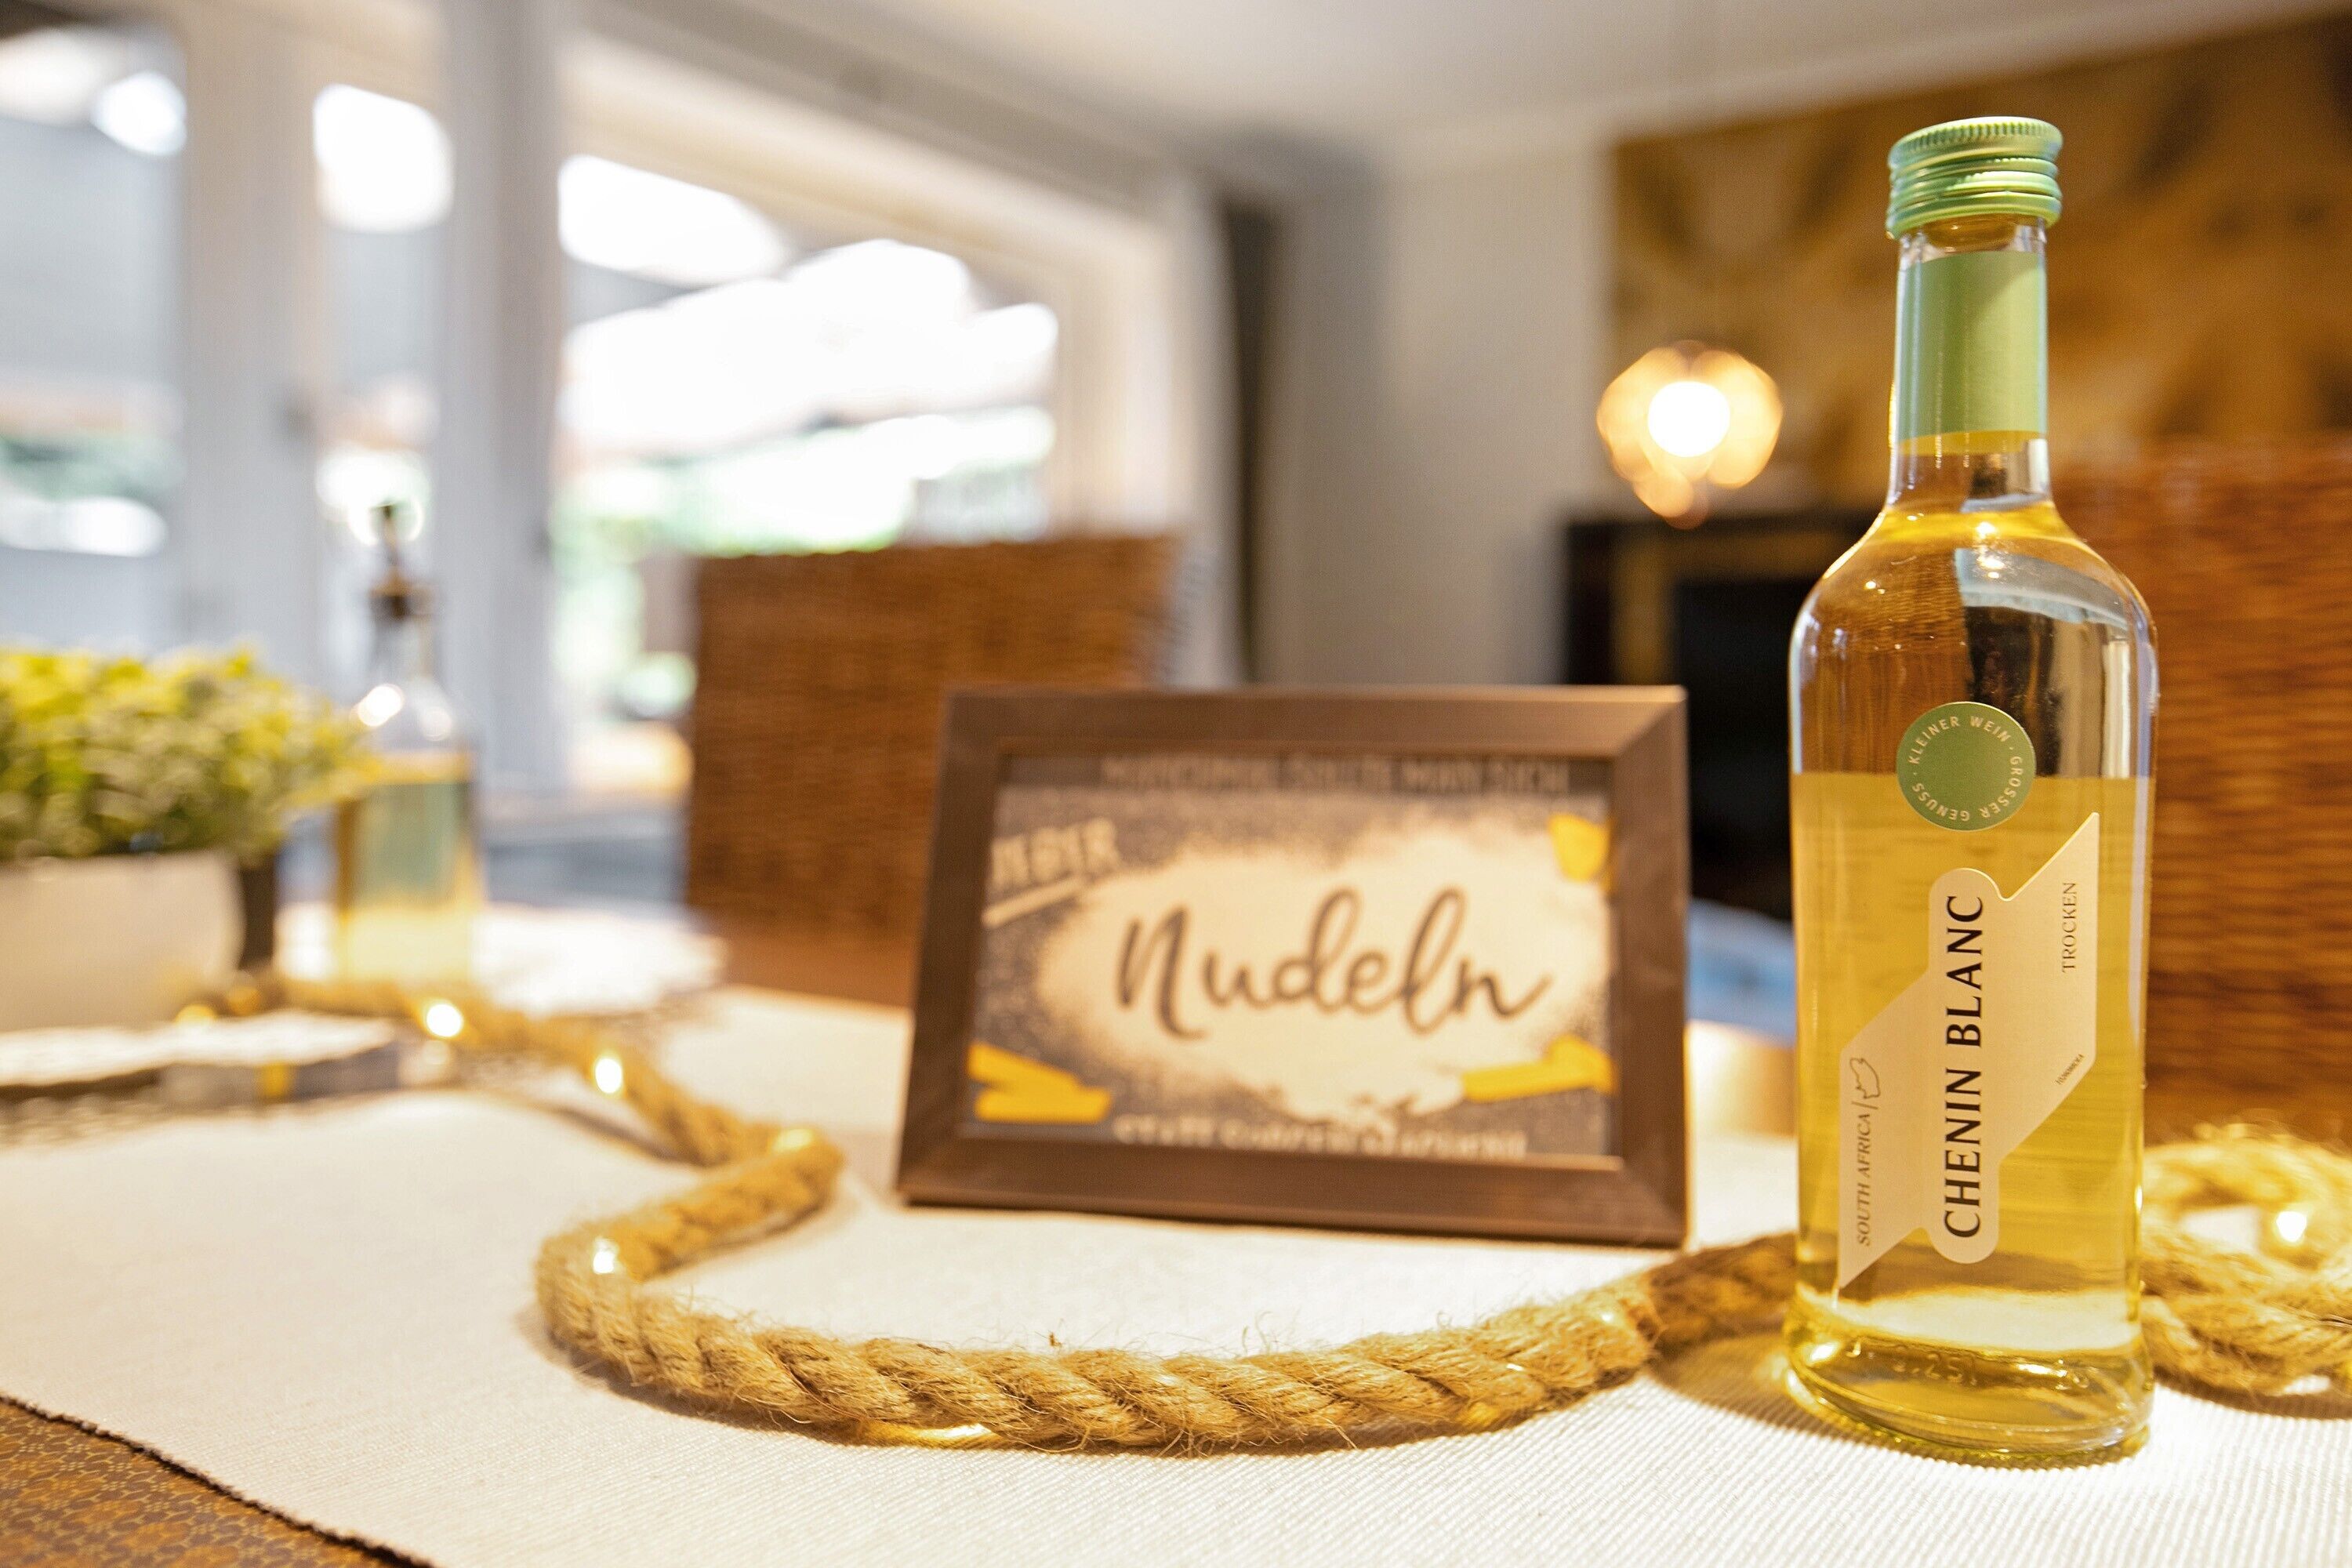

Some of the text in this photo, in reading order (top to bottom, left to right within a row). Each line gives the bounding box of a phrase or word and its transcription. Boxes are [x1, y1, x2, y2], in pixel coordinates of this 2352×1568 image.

[1907, 715, 2025, 822] KLEINER WEIN GROSSER GENUSS
[1114, 884, 1553, 1040] Nudeln
[2061, 881, 2078, 974] TROCKEN
[1944, 895, 1984, 1239] CHENIN BLANC
[1856, 1112, 1871, 1247] SOUTH AFRICA
